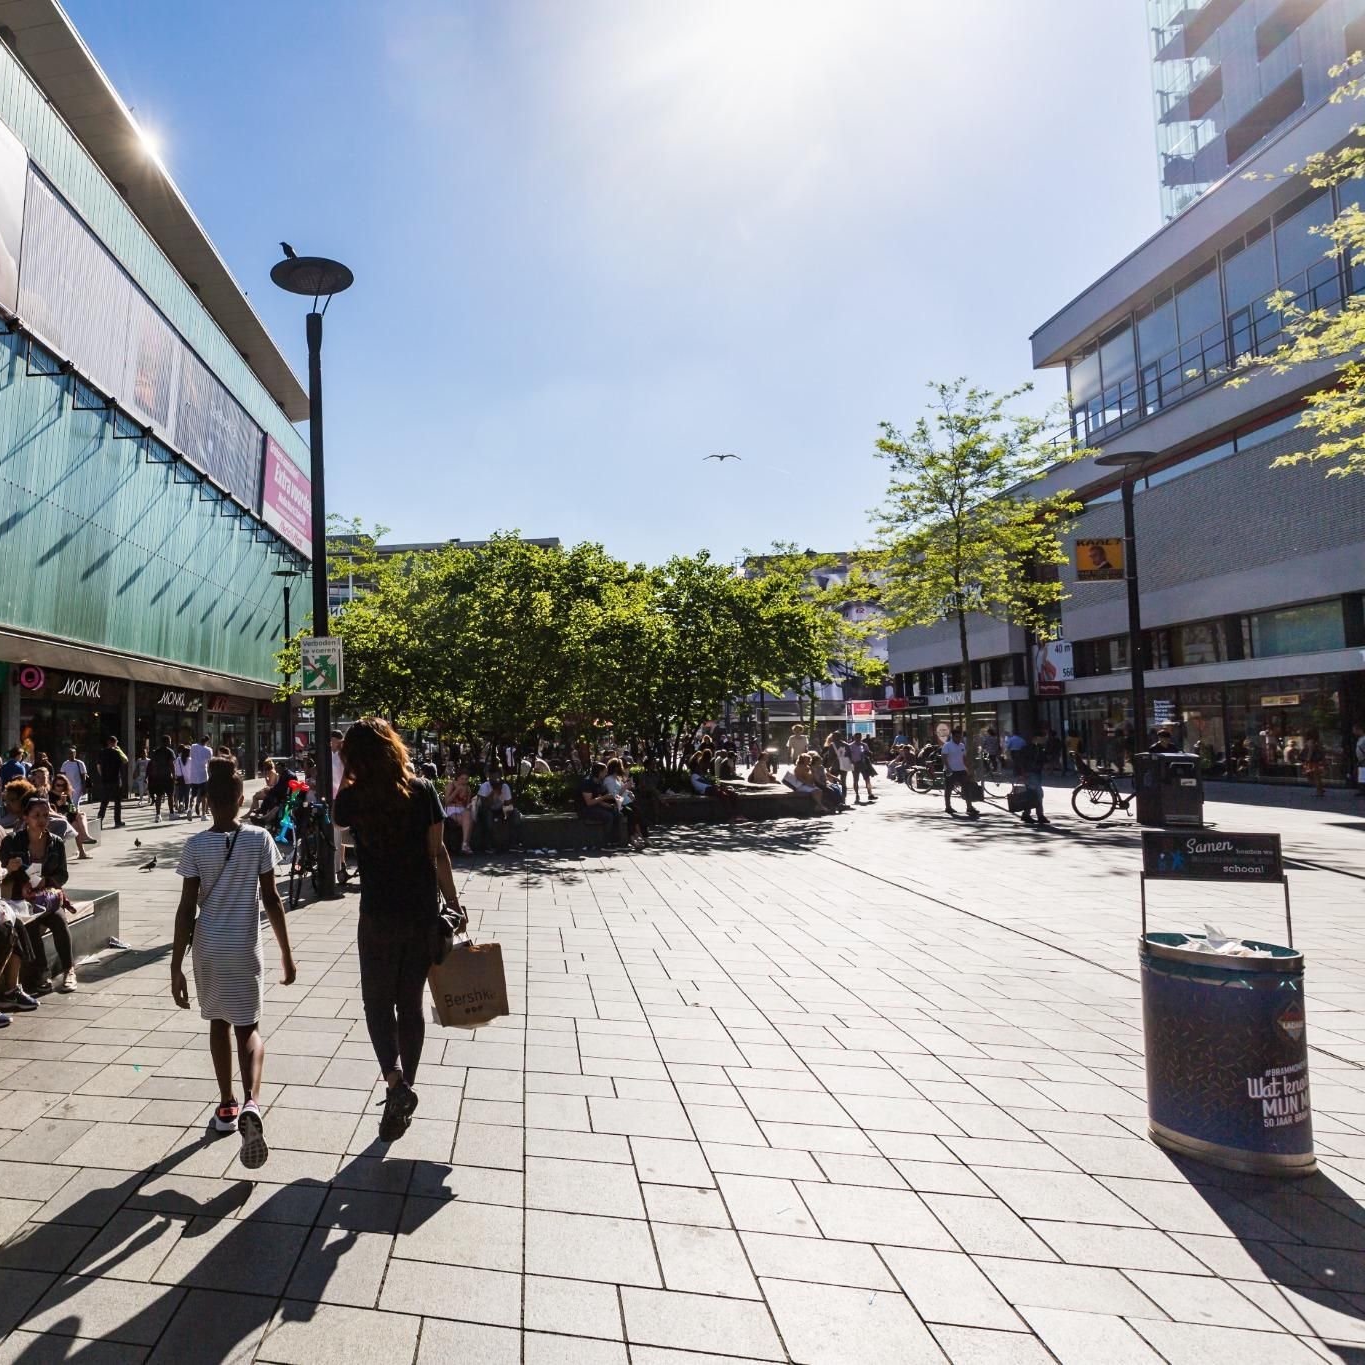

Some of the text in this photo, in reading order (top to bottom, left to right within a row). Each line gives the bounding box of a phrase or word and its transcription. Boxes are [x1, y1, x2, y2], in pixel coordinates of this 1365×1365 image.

[944, 693, 963, 705] ONLY
[1186, 838, 1234, 854] Samen
[1223, 864, 1265, 873] schoon!
[1247, 1076, 1282, 1098] Wat
[1262, 1097, 1298, 1118] MIJN
[1264, 1118, 1275, 1127] 50
[1276, 1116, 1293, 1126] JAAR
